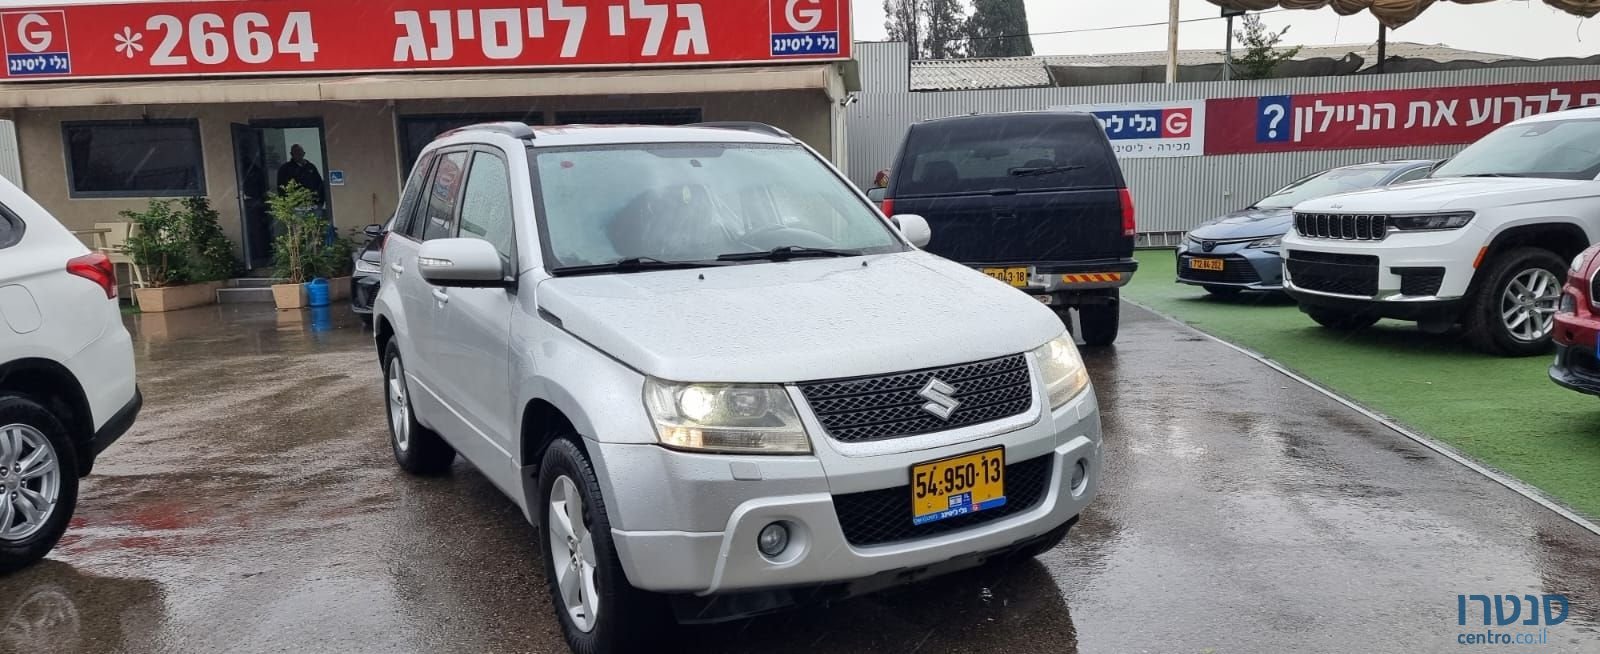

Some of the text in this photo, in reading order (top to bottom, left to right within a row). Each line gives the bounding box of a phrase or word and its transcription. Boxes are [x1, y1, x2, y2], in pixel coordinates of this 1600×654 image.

[784, 0, 822, 31] G
[17, 13, 52, 52] G
[393, 0, 709, 62] גלי ליסינג
[773, 34, 836, 51] גלי ליסינג
[10, 55, 67, 71] גלי ליסינג
[1129, 114, 1157, 132] גלי
[1165, 112, 1188, 134] G
[1263, 88, 1571, 142] לקרוע את הניילון ?
[1157, 142, 1191, 152] מכירה
